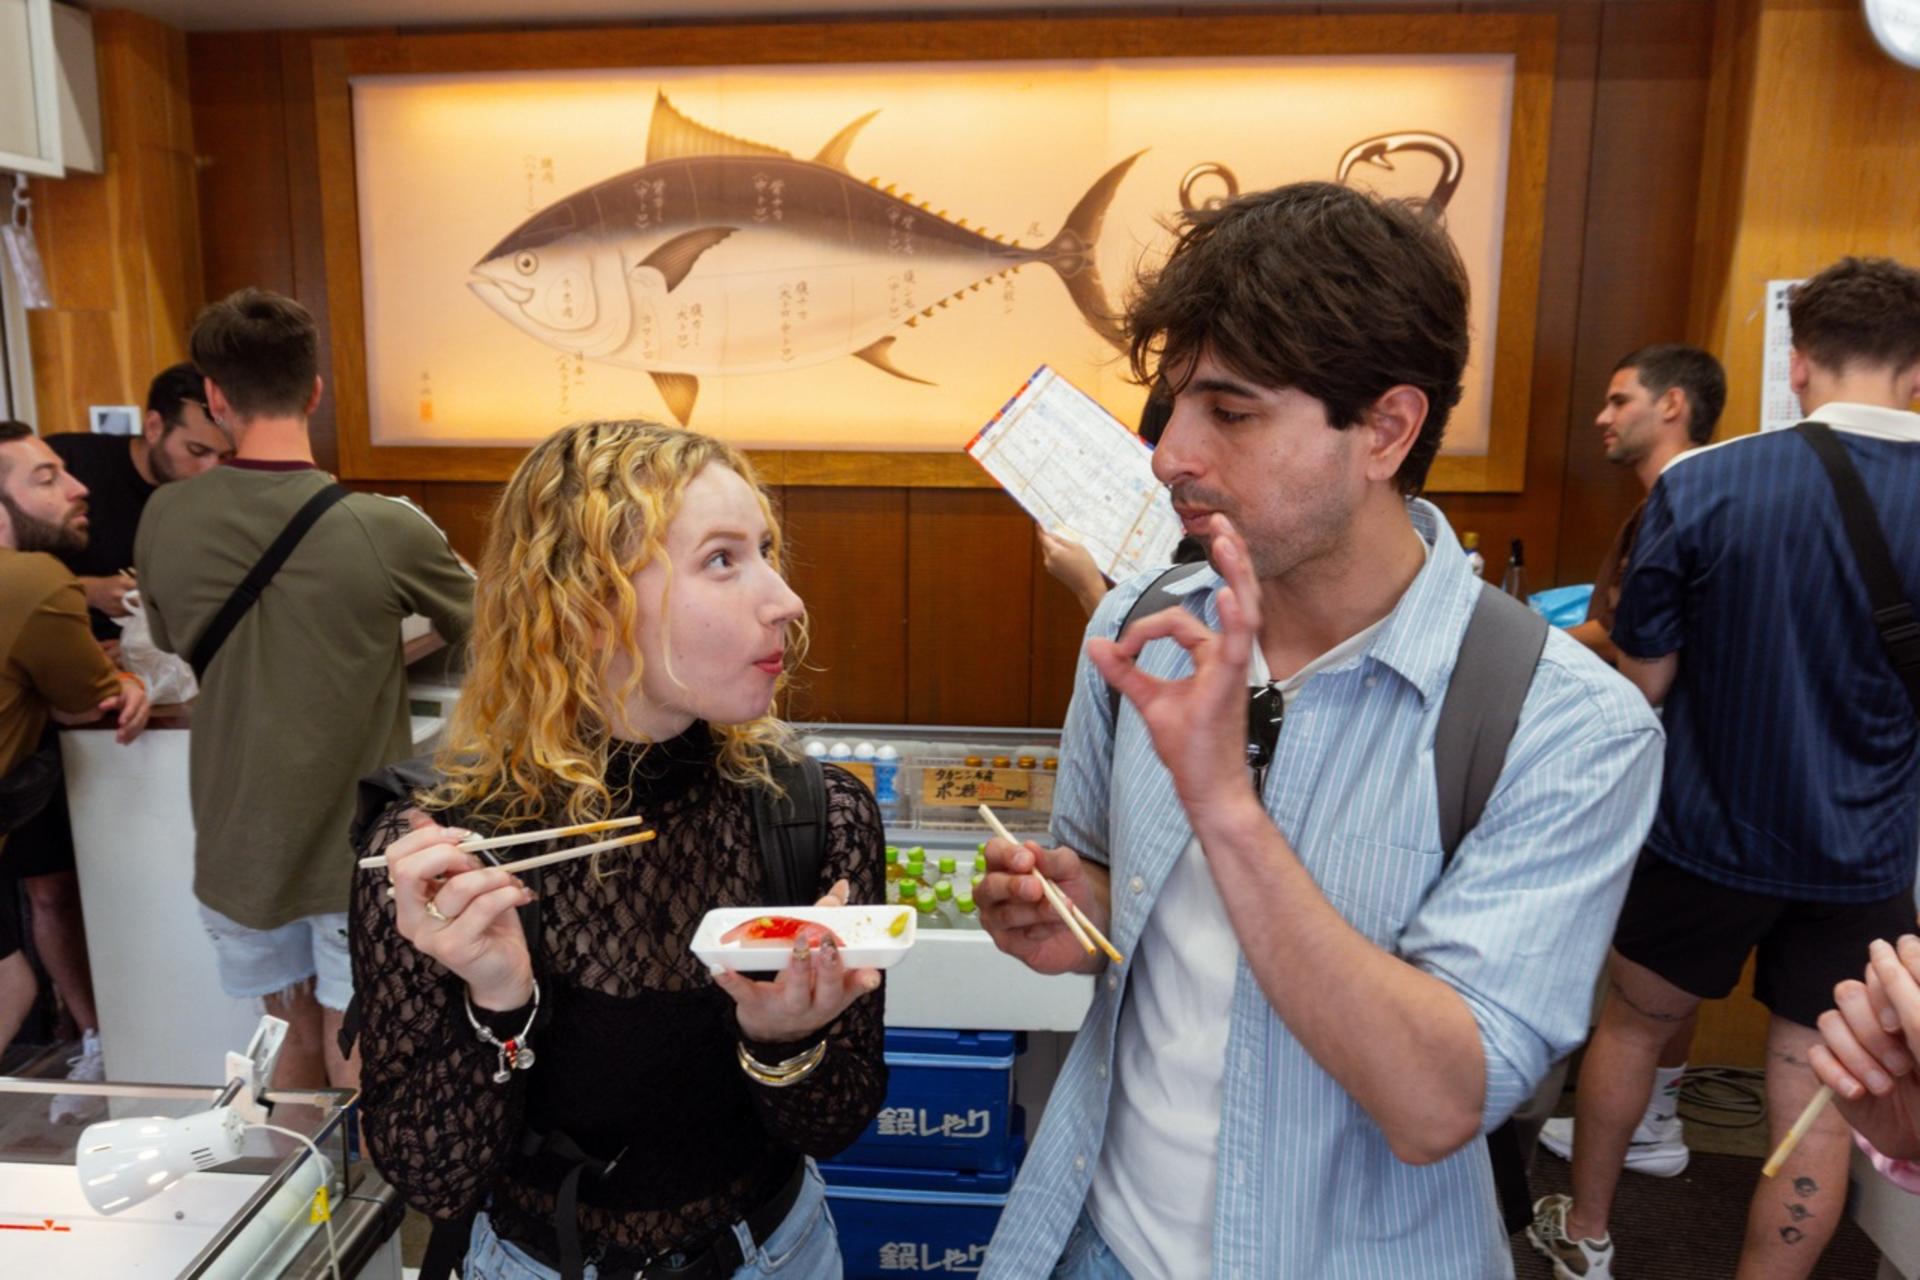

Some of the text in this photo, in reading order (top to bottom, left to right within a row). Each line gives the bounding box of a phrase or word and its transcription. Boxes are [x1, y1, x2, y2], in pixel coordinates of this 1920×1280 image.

[877, 1107, 991, 1138] 銀しゃり
[879, 1241, 989, 1272] 銀しゃり
